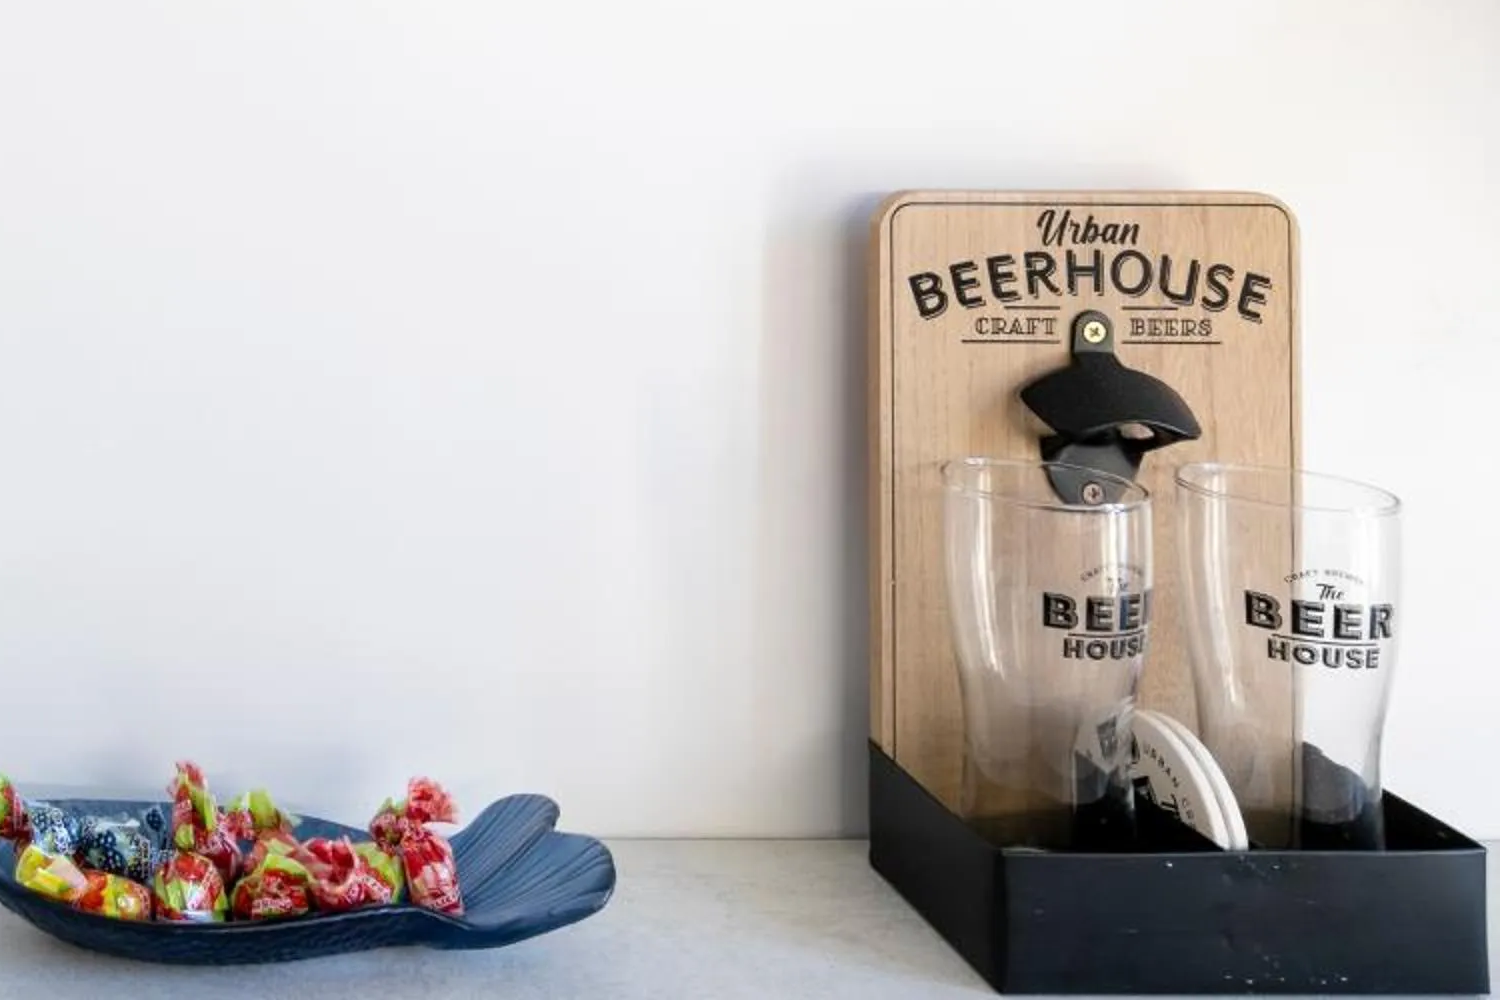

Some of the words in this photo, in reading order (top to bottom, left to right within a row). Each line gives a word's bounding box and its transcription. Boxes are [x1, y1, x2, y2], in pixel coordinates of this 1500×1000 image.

[1035, 208, 1141, 247] Urban
[908, 248, 1273, 325] BEERHOUSE
[974, 317, 1058, 336] CRAFT
[1129, 317, 1213, 337] BEERS
[1315, 583, 1346, 601] The
[1244, 589, 1394, 640] BEER
[1267, 637, 1381, 669] HOUSE
